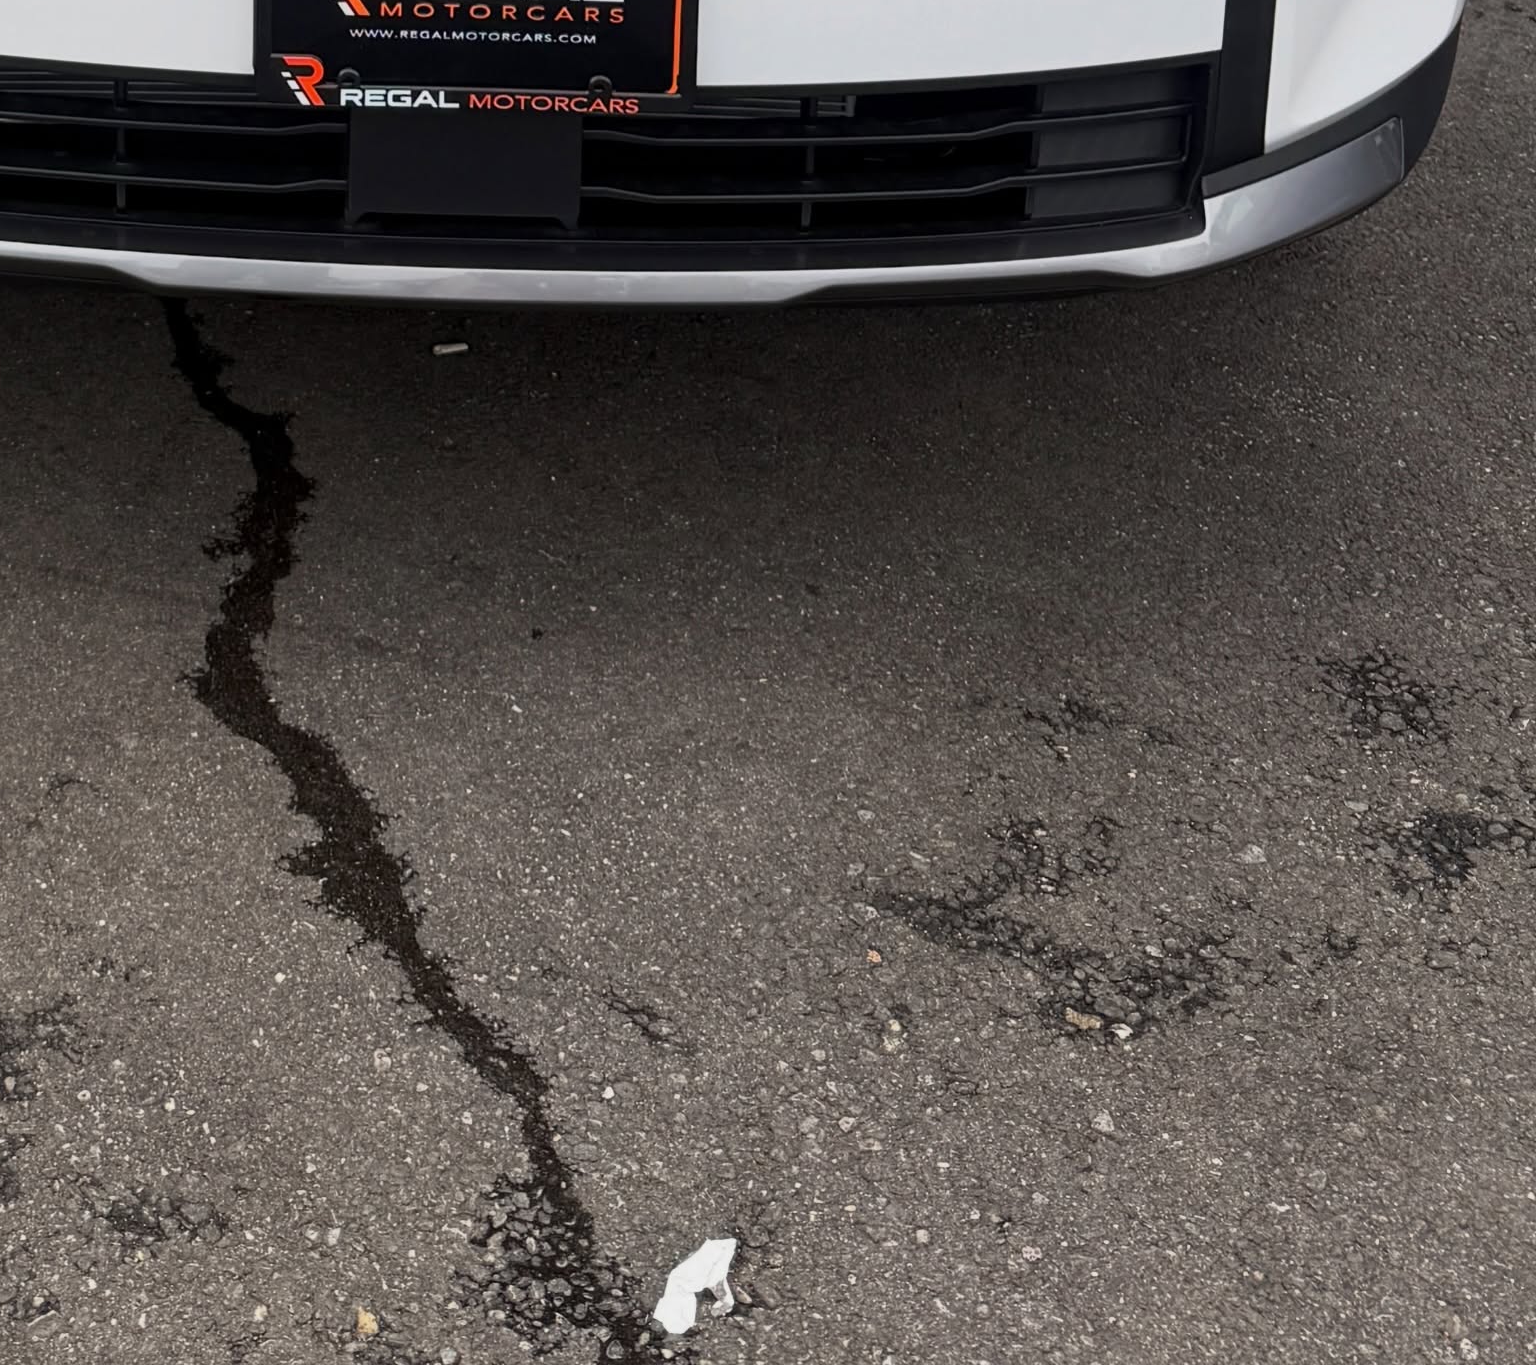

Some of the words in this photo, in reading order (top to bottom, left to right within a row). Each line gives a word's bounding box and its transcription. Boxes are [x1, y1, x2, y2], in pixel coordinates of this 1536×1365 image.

[379, 2, 625, 24] MOTORCARS
[349, 28, 597, 45] WWW.REGALMOTORCARS.COM
[339, 88, 460, 109] REGAL
[468, 93, 639, 114] MOTORCARS
